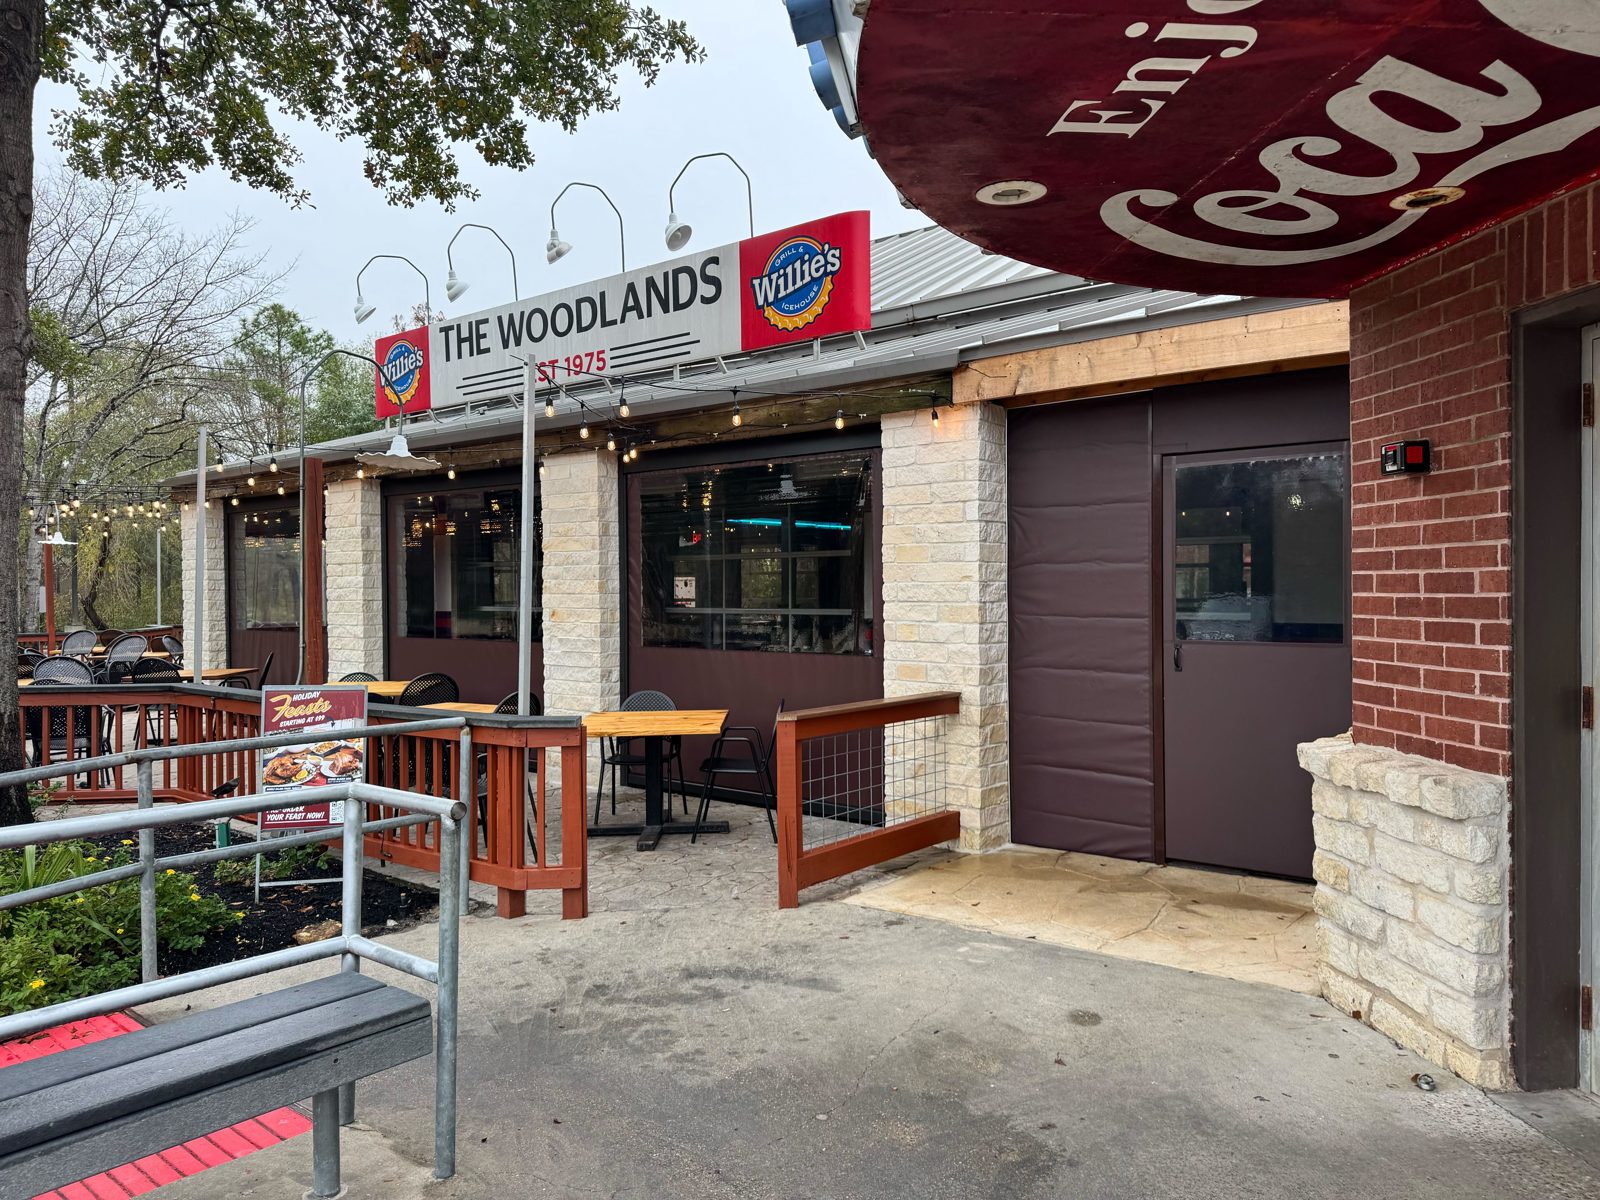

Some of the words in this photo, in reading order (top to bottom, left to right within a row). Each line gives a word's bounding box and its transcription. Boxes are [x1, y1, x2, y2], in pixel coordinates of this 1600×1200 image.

[1046, 0, 1263, 139] Enj
[1100, 54, 1545, 267] Coca
[774, 247, 797, 267] GRILL
[798, 245, 804, 253] &
[752, 243, 841, 306] Willie's
[438, 317, 491, 363] THE
[497, 255, 723, 350] WOODLANDS
[781, 284, 819, 311] ICEHOUSE
[380, 346, 424, 387] Willie's
[564, 349, 607, 377] 1975
[269, 693, 332, 723] Feasts
[292, 690, 321, 702] HOLIDAY
[279, 718, 306, 728] STARTING
[266, 813, 284, 822] YOUR
[284, 812, 306, 821] FEAST
[306, 811, 325, 819] NOW!
